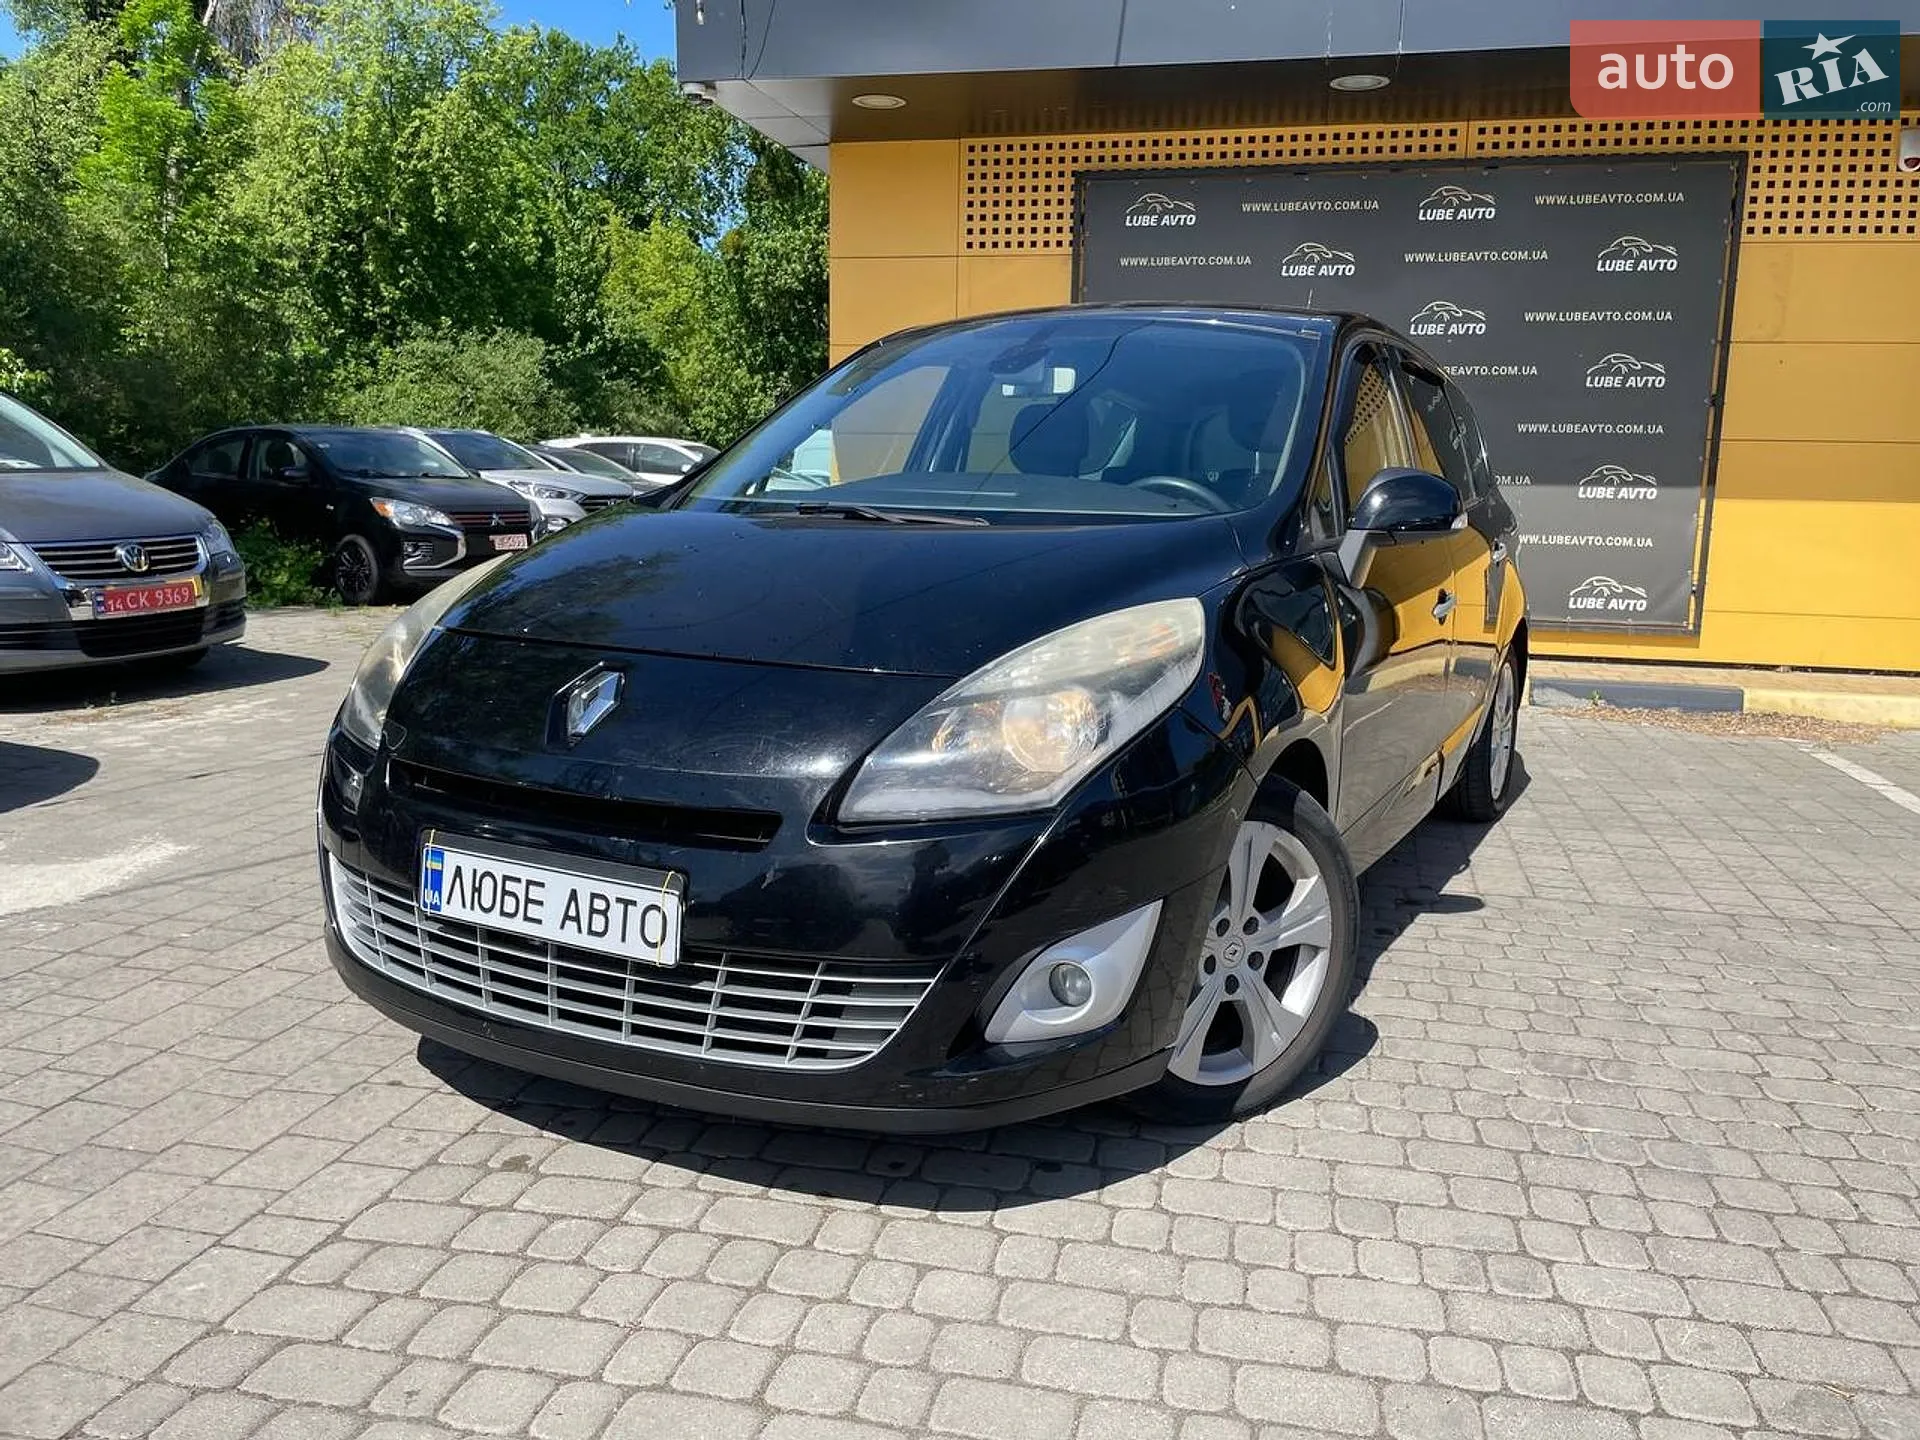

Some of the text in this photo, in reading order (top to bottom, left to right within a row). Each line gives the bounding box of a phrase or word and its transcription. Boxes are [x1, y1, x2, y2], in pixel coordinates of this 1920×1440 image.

[1534, 192, 1685, 205] WWW.LUBEAVTO.COM.UA
[1241, 199, 1379, 212] WWW.LUBEAVTO.COM.UA
[1125, 213, 1197, 227] LUBE AVTO
[1418, 207, 1496, 221] LUBE AVTO
[1119, 255, 1252, 267] WWW.LUBEAVTO.COM.UA
[1404, 250, 1549, 263] WWW.LUBEAVTO.COM.UA
[1281, 264, 1356, 277] LUBE AVTO
[1596, 258, 1678, 273] LUBE AVTO
[1524, 311, 1673, 322] WWW.LUBEAVTO.COM.UA
[1409, 322, 1487, 336] LUBE AVTO
[1443, 365, 1538, 376] BEAVTO.COM.UA
[1585, 375, 1666, 388] LUBE AVTO
[1517, 423, 1664, 434] WWW.LUBEAVTO.COM.UA
[1578, 486, 1658, 500] LUBE AVTO
[1518, 534, 1654, 548] WW.LUBEAVTO.COM.UA
[107, 598, 123, 611] 14
[155, 586, 189, 606] 9369
[1568, 597, 1648, 612] LUBE AVTO
